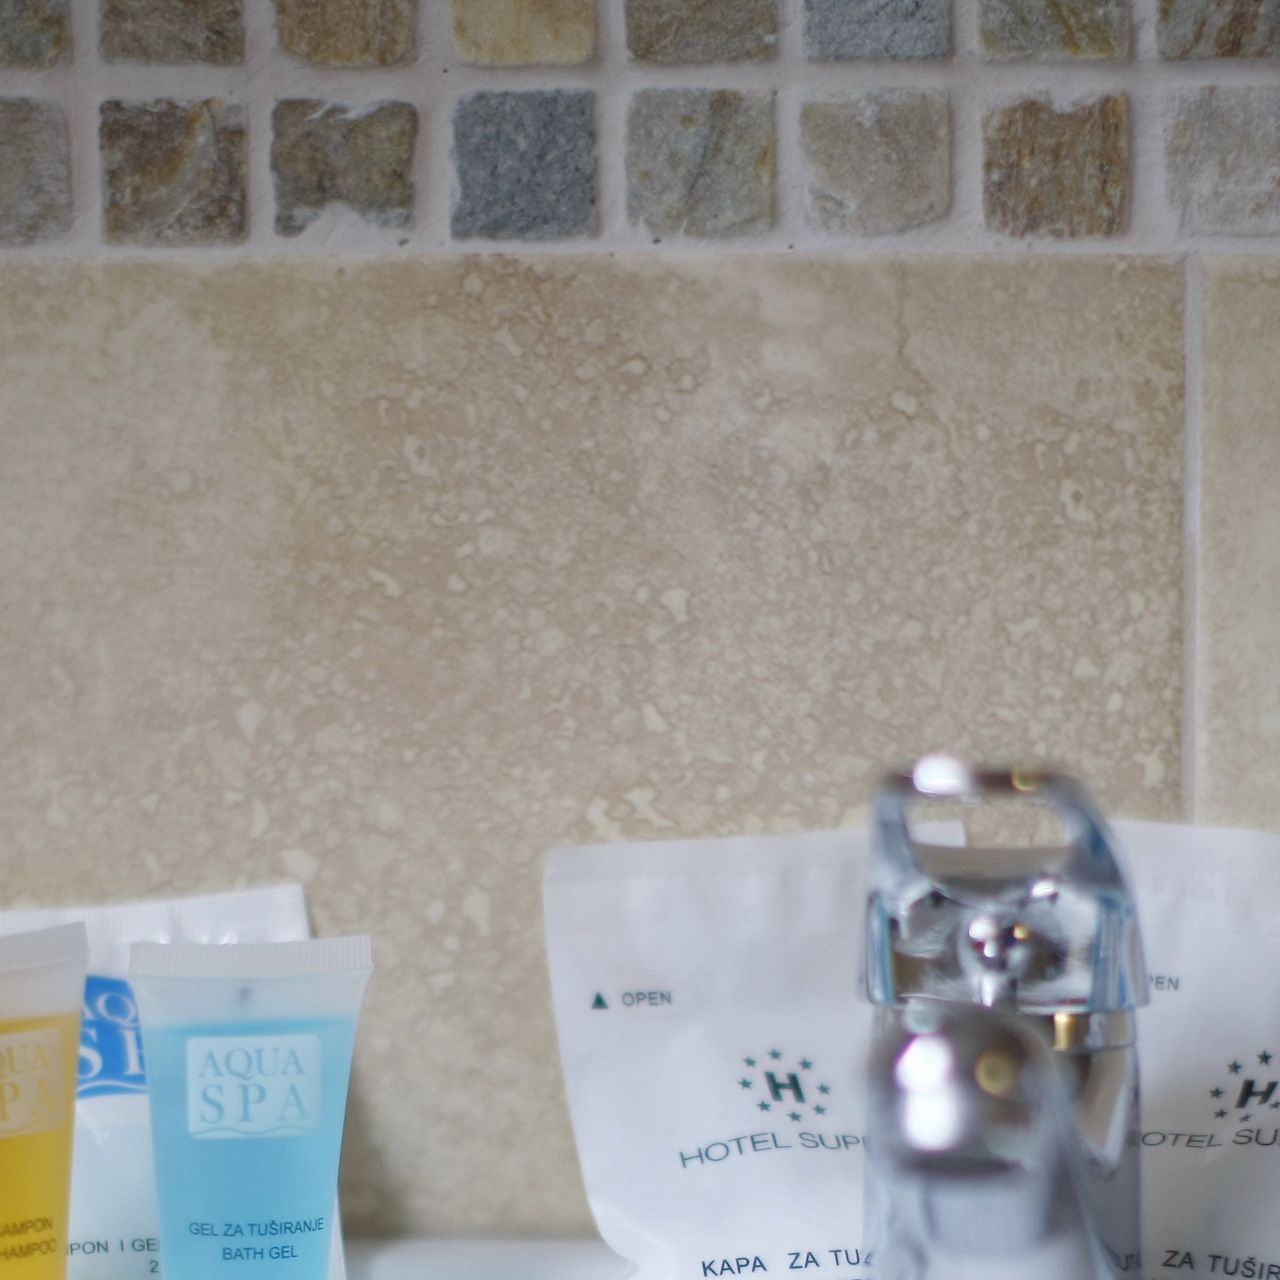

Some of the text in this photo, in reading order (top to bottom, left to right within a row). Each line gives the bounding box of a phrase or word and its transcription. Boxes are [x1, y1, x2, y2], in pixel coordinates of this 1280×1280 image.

[1149, 975, 1180, 991] EN
[621, 991, 672, 1007] OPEN
[198, 1047, 307, 1081] AQUA
[764, 1071, 806, 1103] H
[1235, 1079, 1279, 1109] H
[199, 1082, 310, 1124] SPA
[1138, 1131, 1223, 1149] OTEL
[679, 1132, 866, 1169] HOTEL SUP
[189, 1217, 324, 1237] GEL ZA TUŠIRANJE
[67, 1240, 109, 1255] PON
[131, 1238, 160, 1252] GE
[222, 1245, 299, 1261] BATH GEL
[701, 1248, 868, 1278] KAPA ZA TU
[1162, 1250, 1195, 1270] ZA
